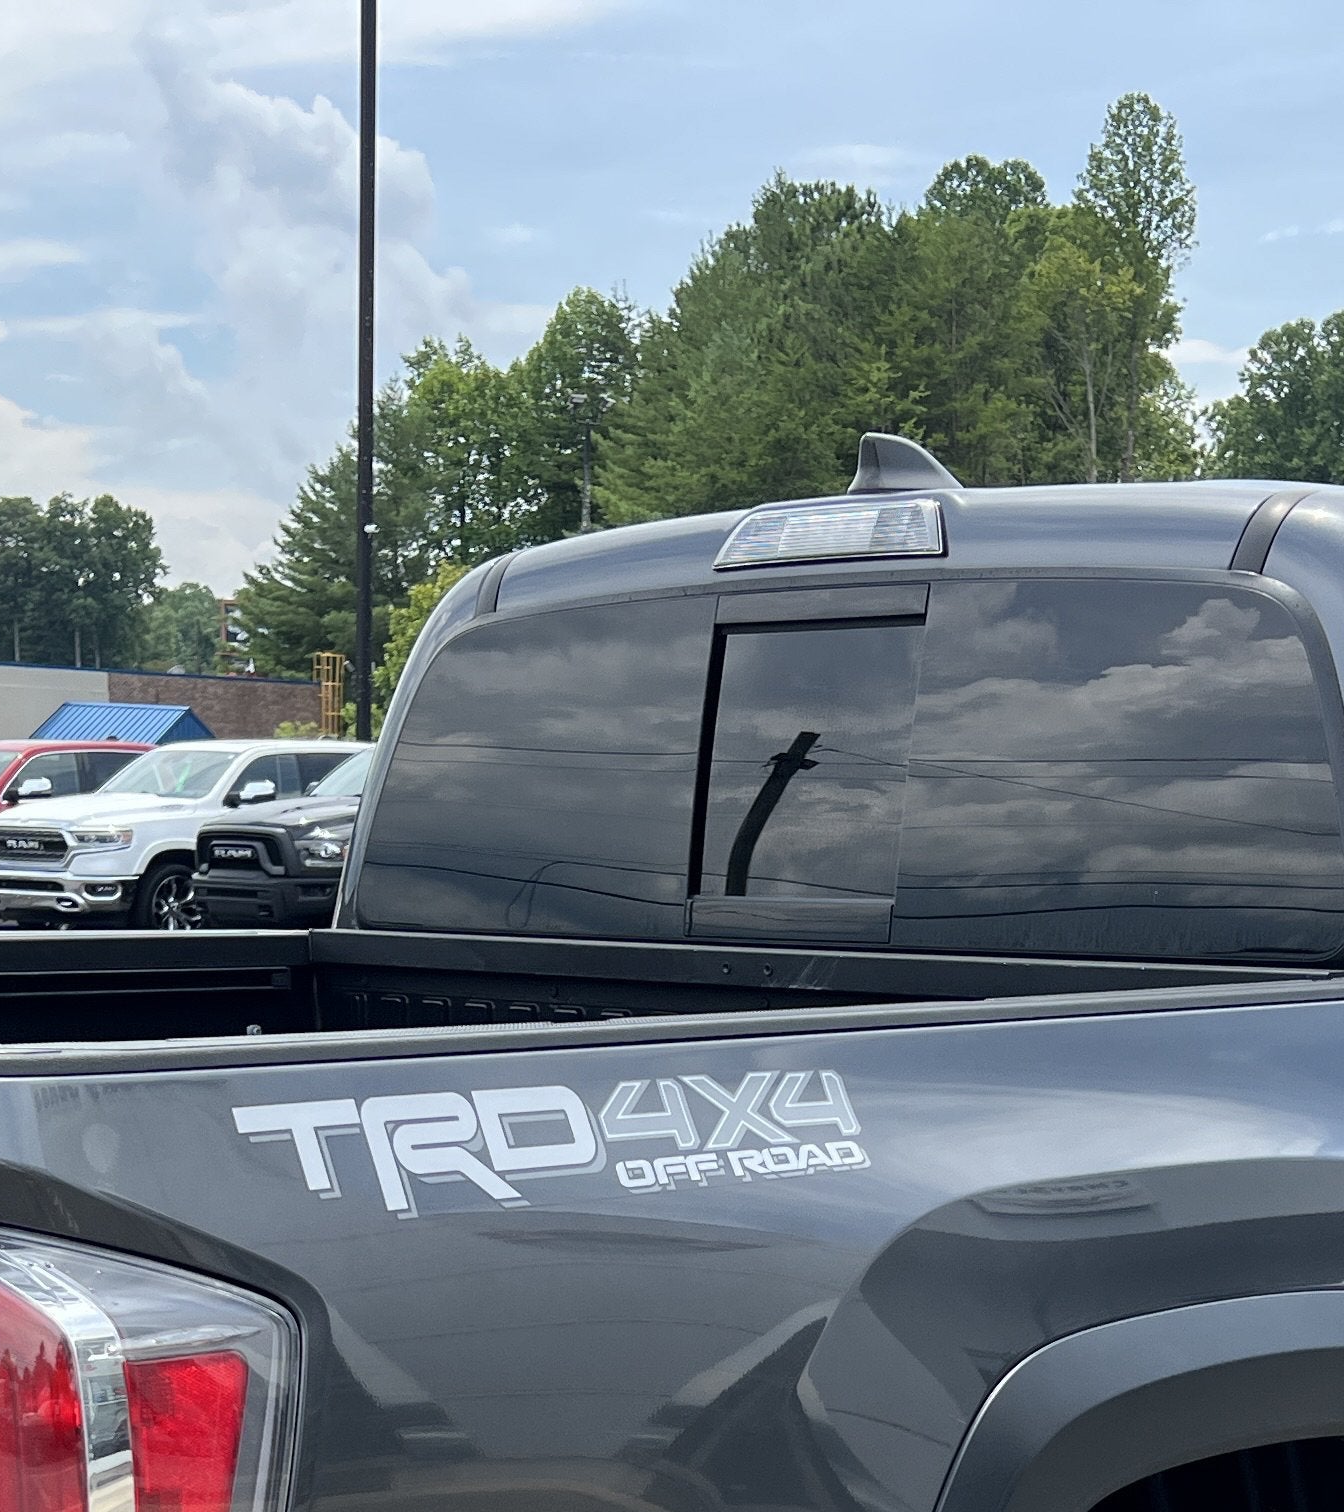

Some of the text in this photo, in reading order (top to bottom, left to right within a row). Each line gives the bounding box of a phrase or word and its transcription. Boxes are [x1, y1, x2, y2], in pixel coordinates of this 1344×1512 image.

[231, 1085, 603, 1219] TRD
[615, 1140, 871, 1191] OFF ROAD
